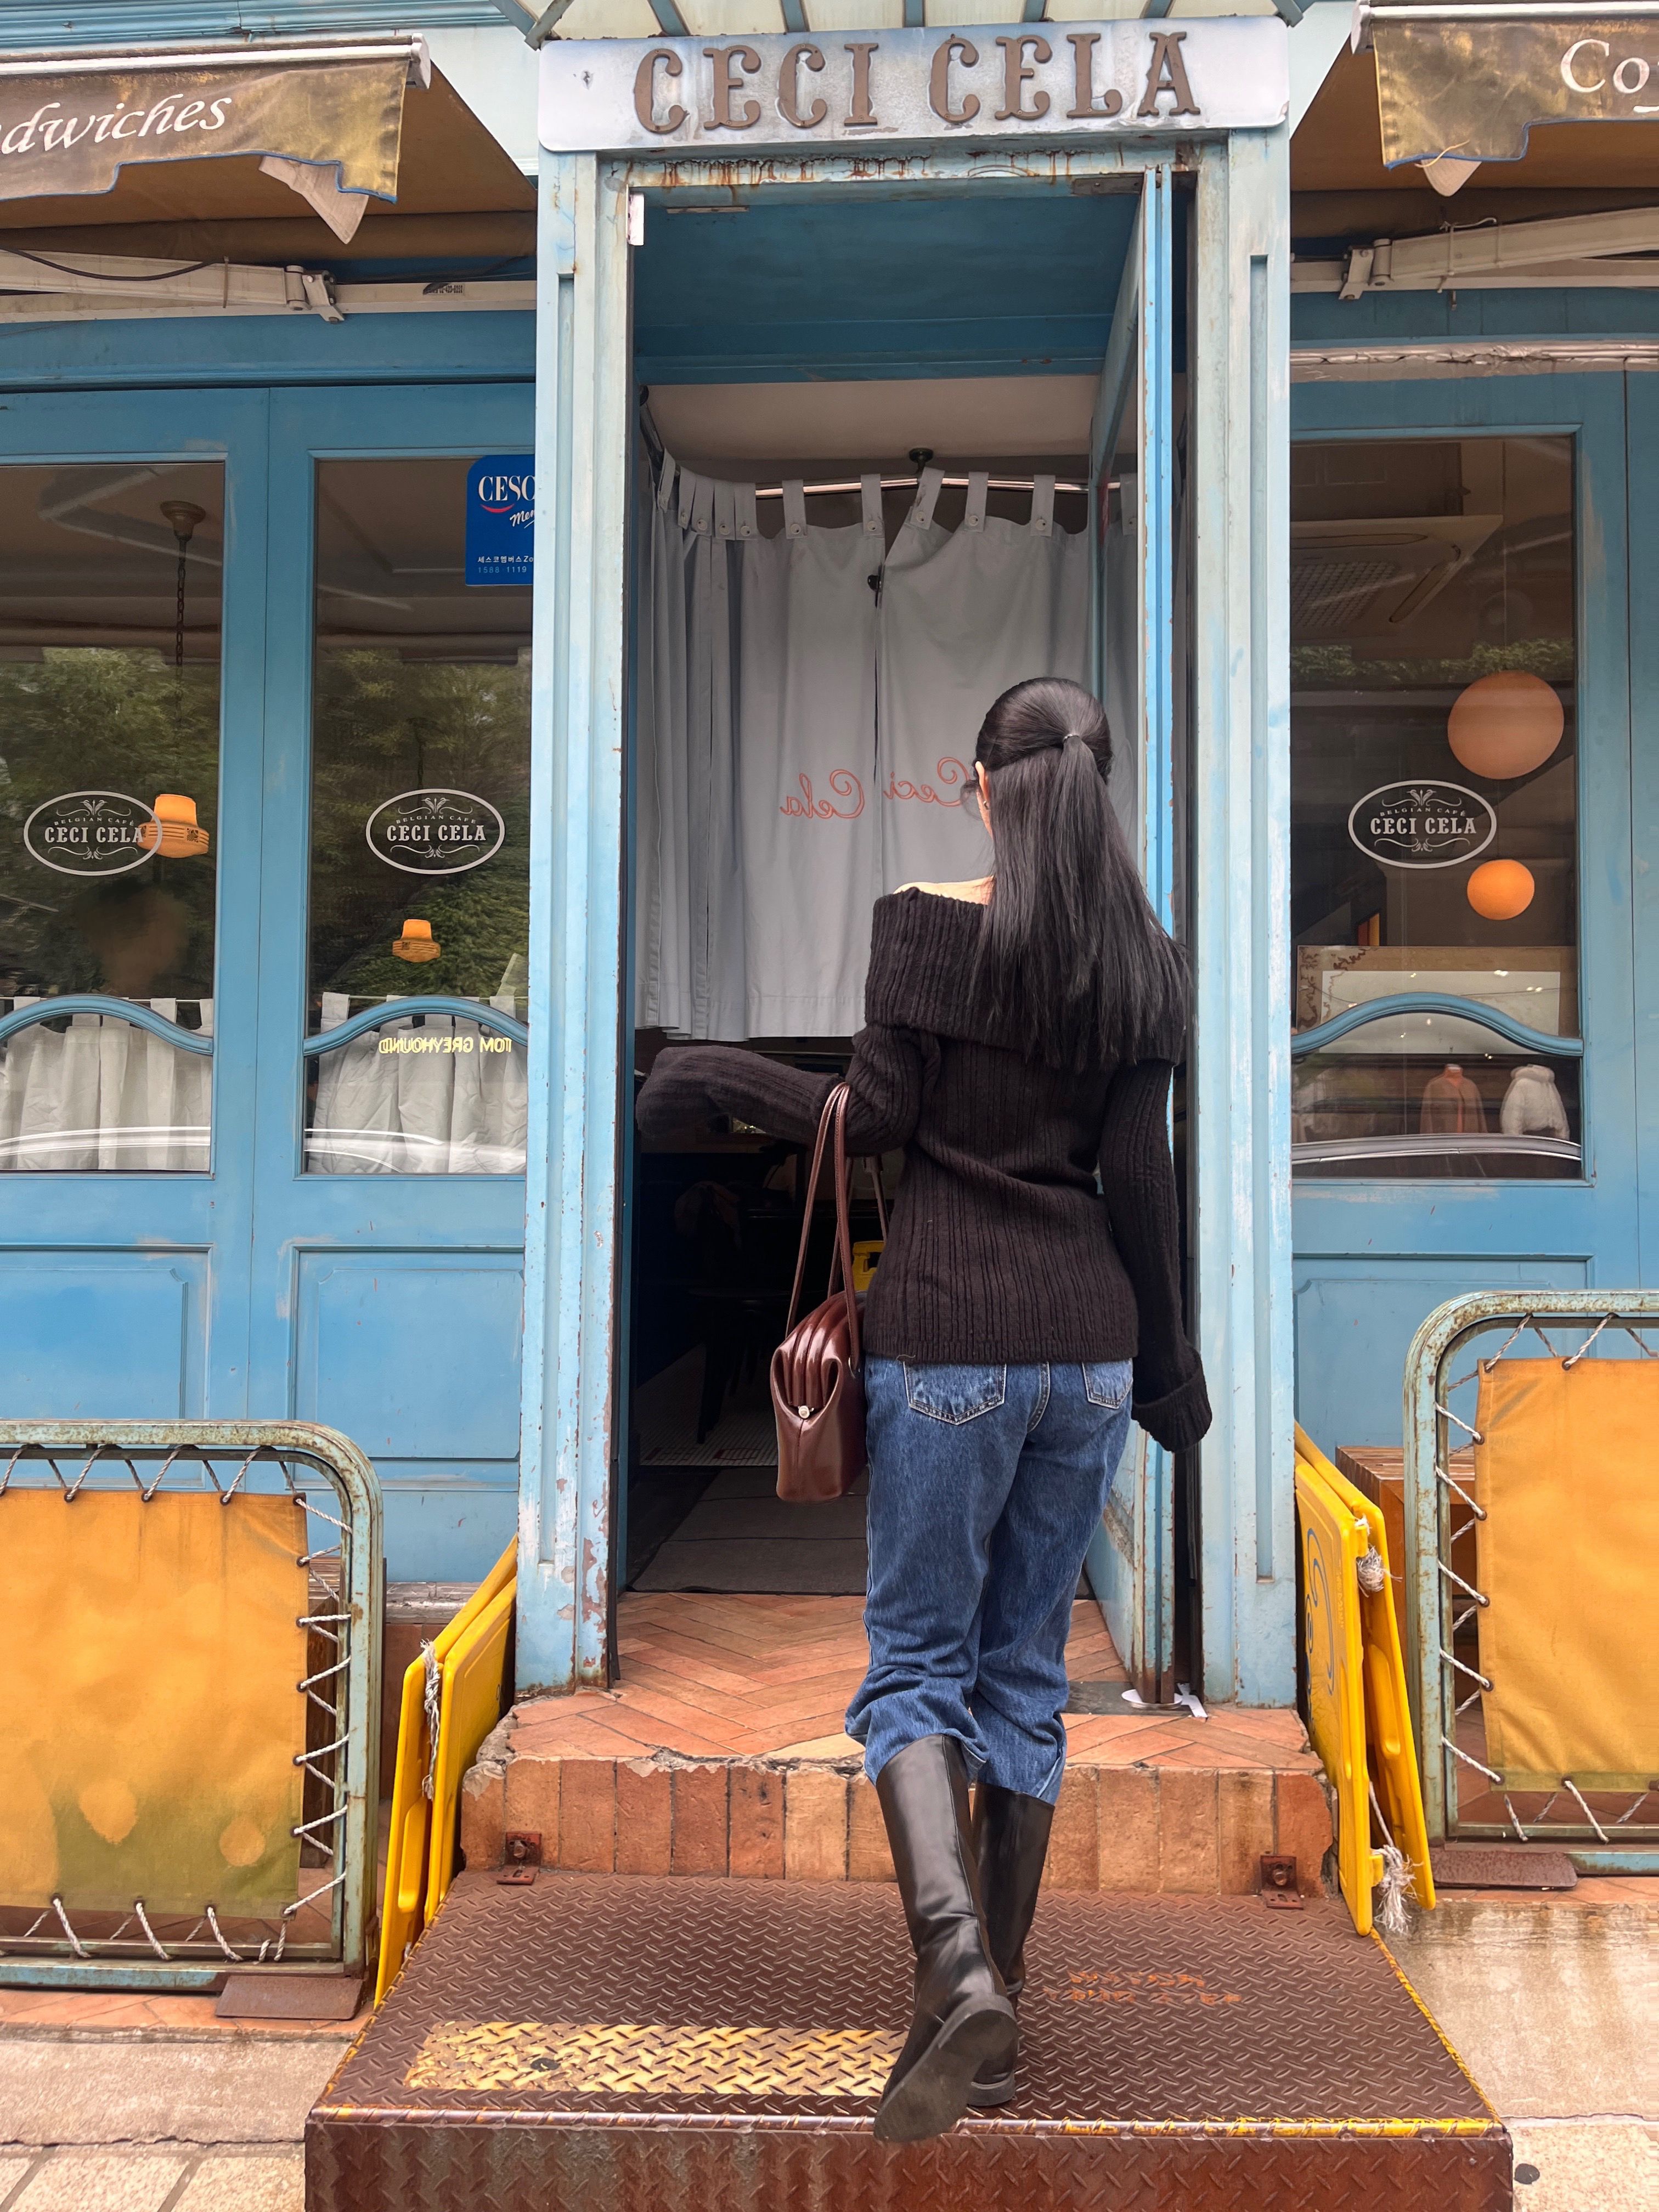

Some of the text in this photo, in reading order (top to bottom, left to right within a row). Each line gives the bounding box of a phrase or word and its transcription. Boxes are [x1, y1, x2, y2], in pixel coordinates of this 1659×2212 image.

[634, 31, 1203, 135] CECI CELA
[1560, 38, 1659, 112] Co
[0, 93, 232, 154] dwiches
[396, 815, 444, 824] BELGIAN
[1380, 808, 1431, 816] BELGIAN
[54, 817, 102, 826] BELGIAN
[1370, 817, 1476, 834] CECI CELA
[44, 827, 143, 843] CECI CELA
[387, 825, 486, 841] CECI CELA
